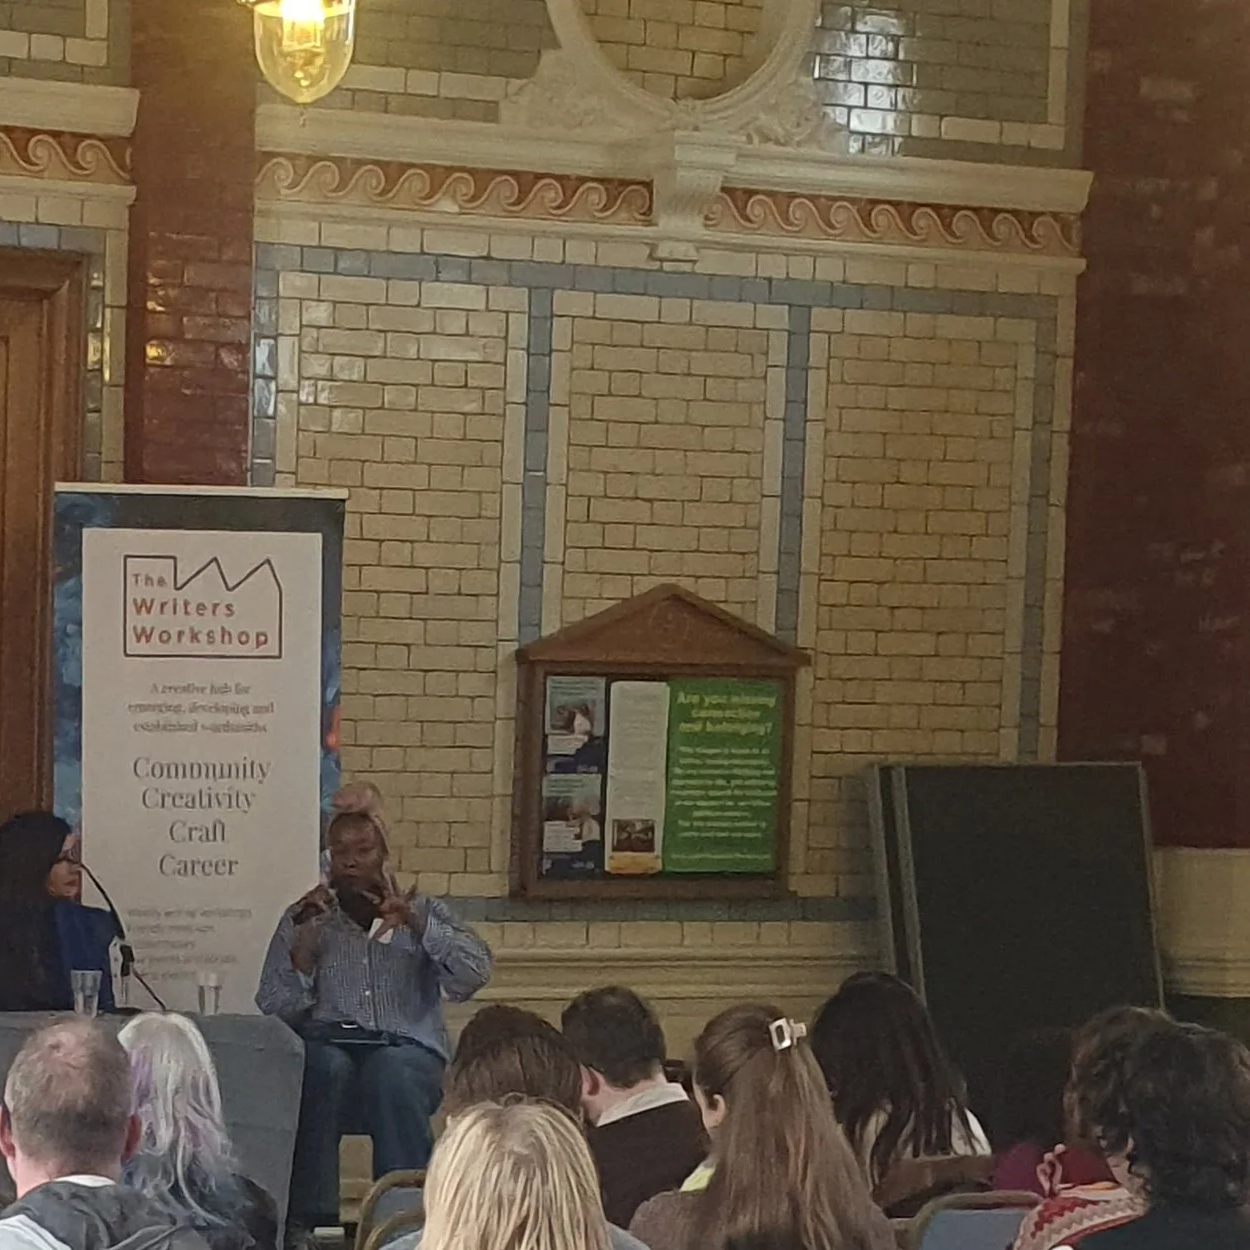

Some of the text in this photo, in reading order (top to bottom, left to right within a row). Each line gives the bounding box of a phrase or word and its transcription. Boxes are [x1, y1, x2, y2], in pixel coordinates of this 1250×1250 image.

[133, 573, 167, 587] The
[132, 597, 235, 617] Writers
[132, 625, 269, 649] Workshop
[133, 756, 271, 785] Community
[142, 786, 257, 814] Creativity
[169, 818, 228, 844] Craft
[159, 853, 239, 877] Career
